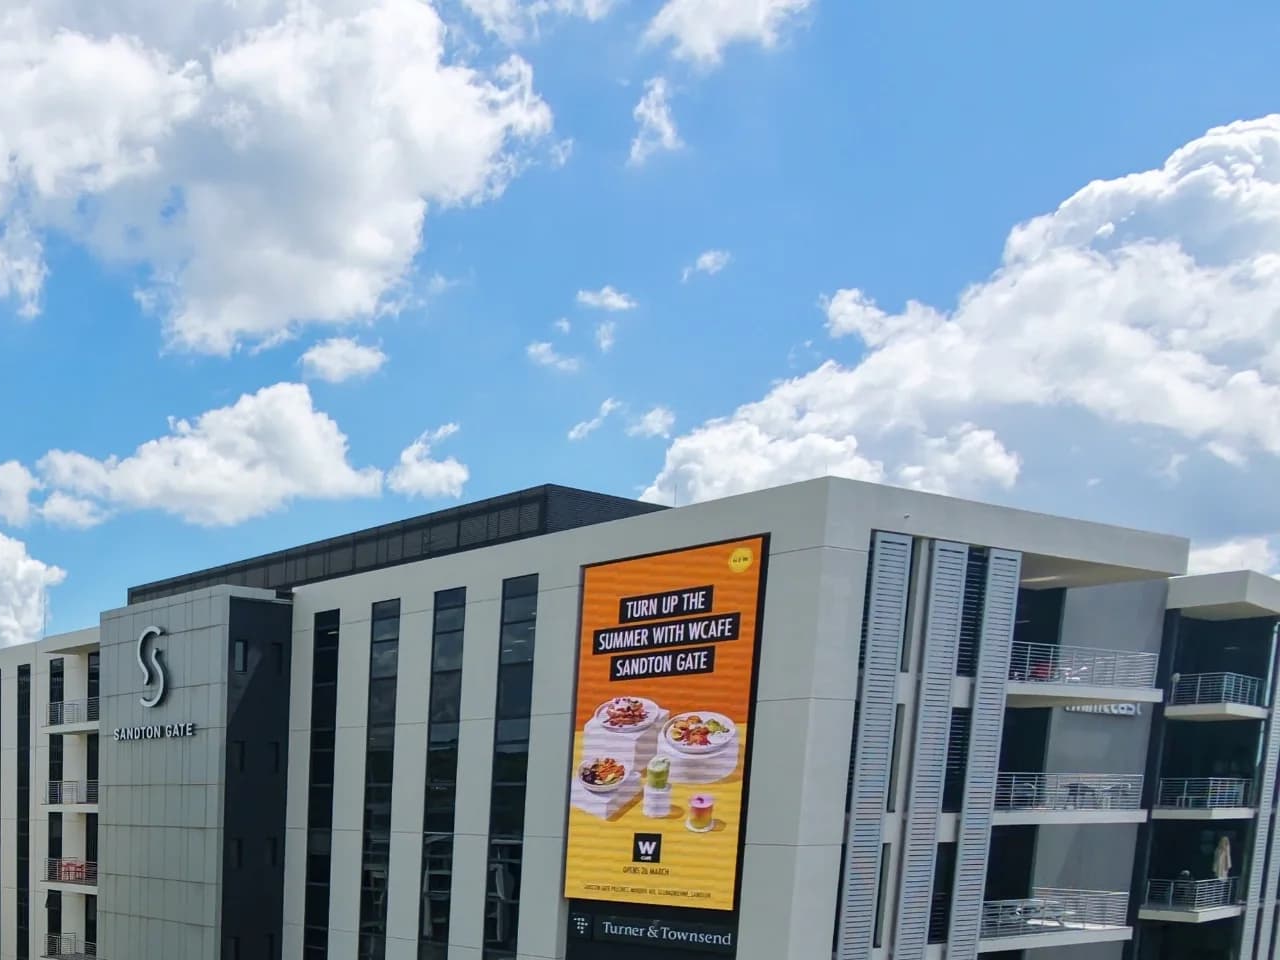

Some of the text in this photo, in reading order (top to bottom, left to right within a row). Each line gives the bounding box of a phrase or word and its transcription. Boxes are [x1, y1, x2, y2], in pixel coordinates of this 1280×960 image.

[626, 591, 706, 619] TURN UP THE
[599, 618, 733, 650] SUMMER WITH WCAFE
[615, 651, 708, 677] SANDTON GATE
[113, 723, 193, 741] SANDTON GATE
[602, 921, 732, 945] Turner & Townsend
